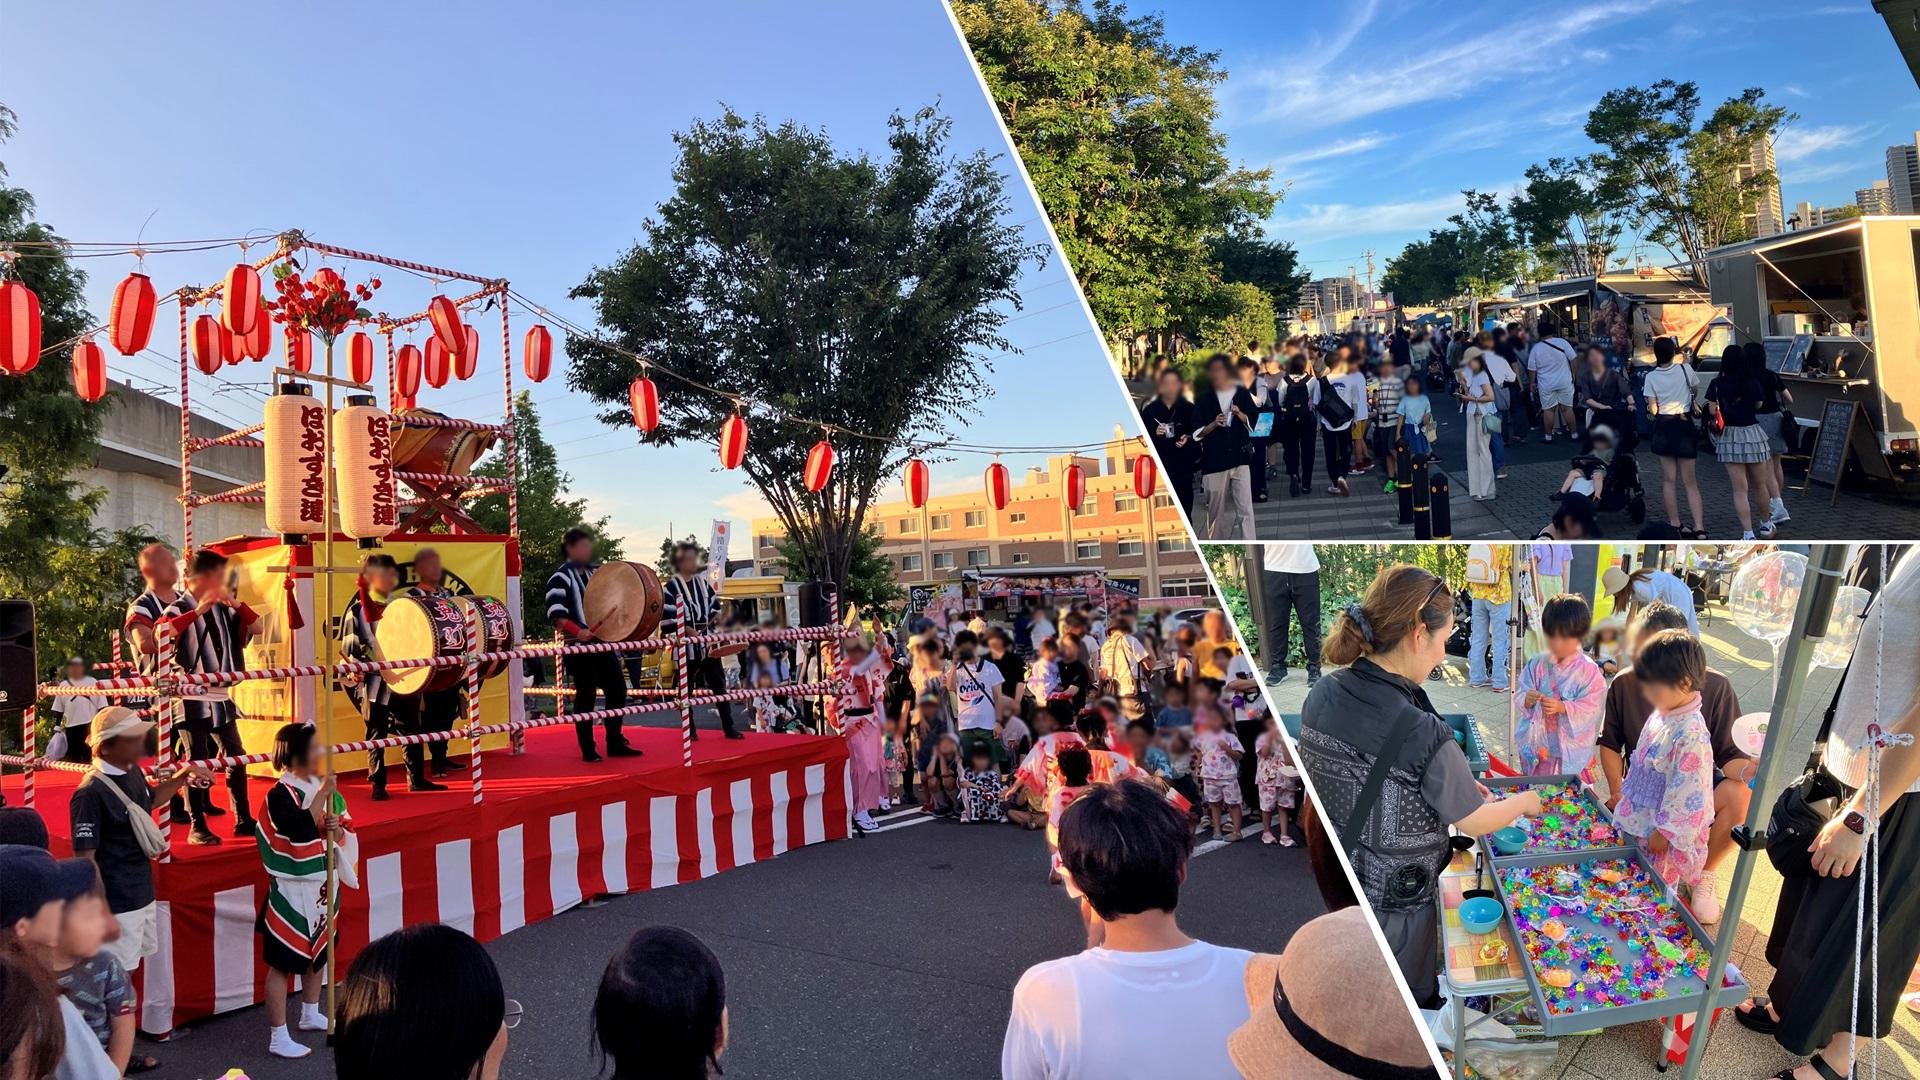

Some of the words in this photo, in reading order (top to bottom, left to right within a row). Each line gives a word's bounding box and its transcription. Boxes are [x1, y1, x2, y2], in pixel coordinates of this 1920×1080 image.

[299, 405, 325, 522] ほおずき連
[367, 416, 395, 525] ほおずき連
